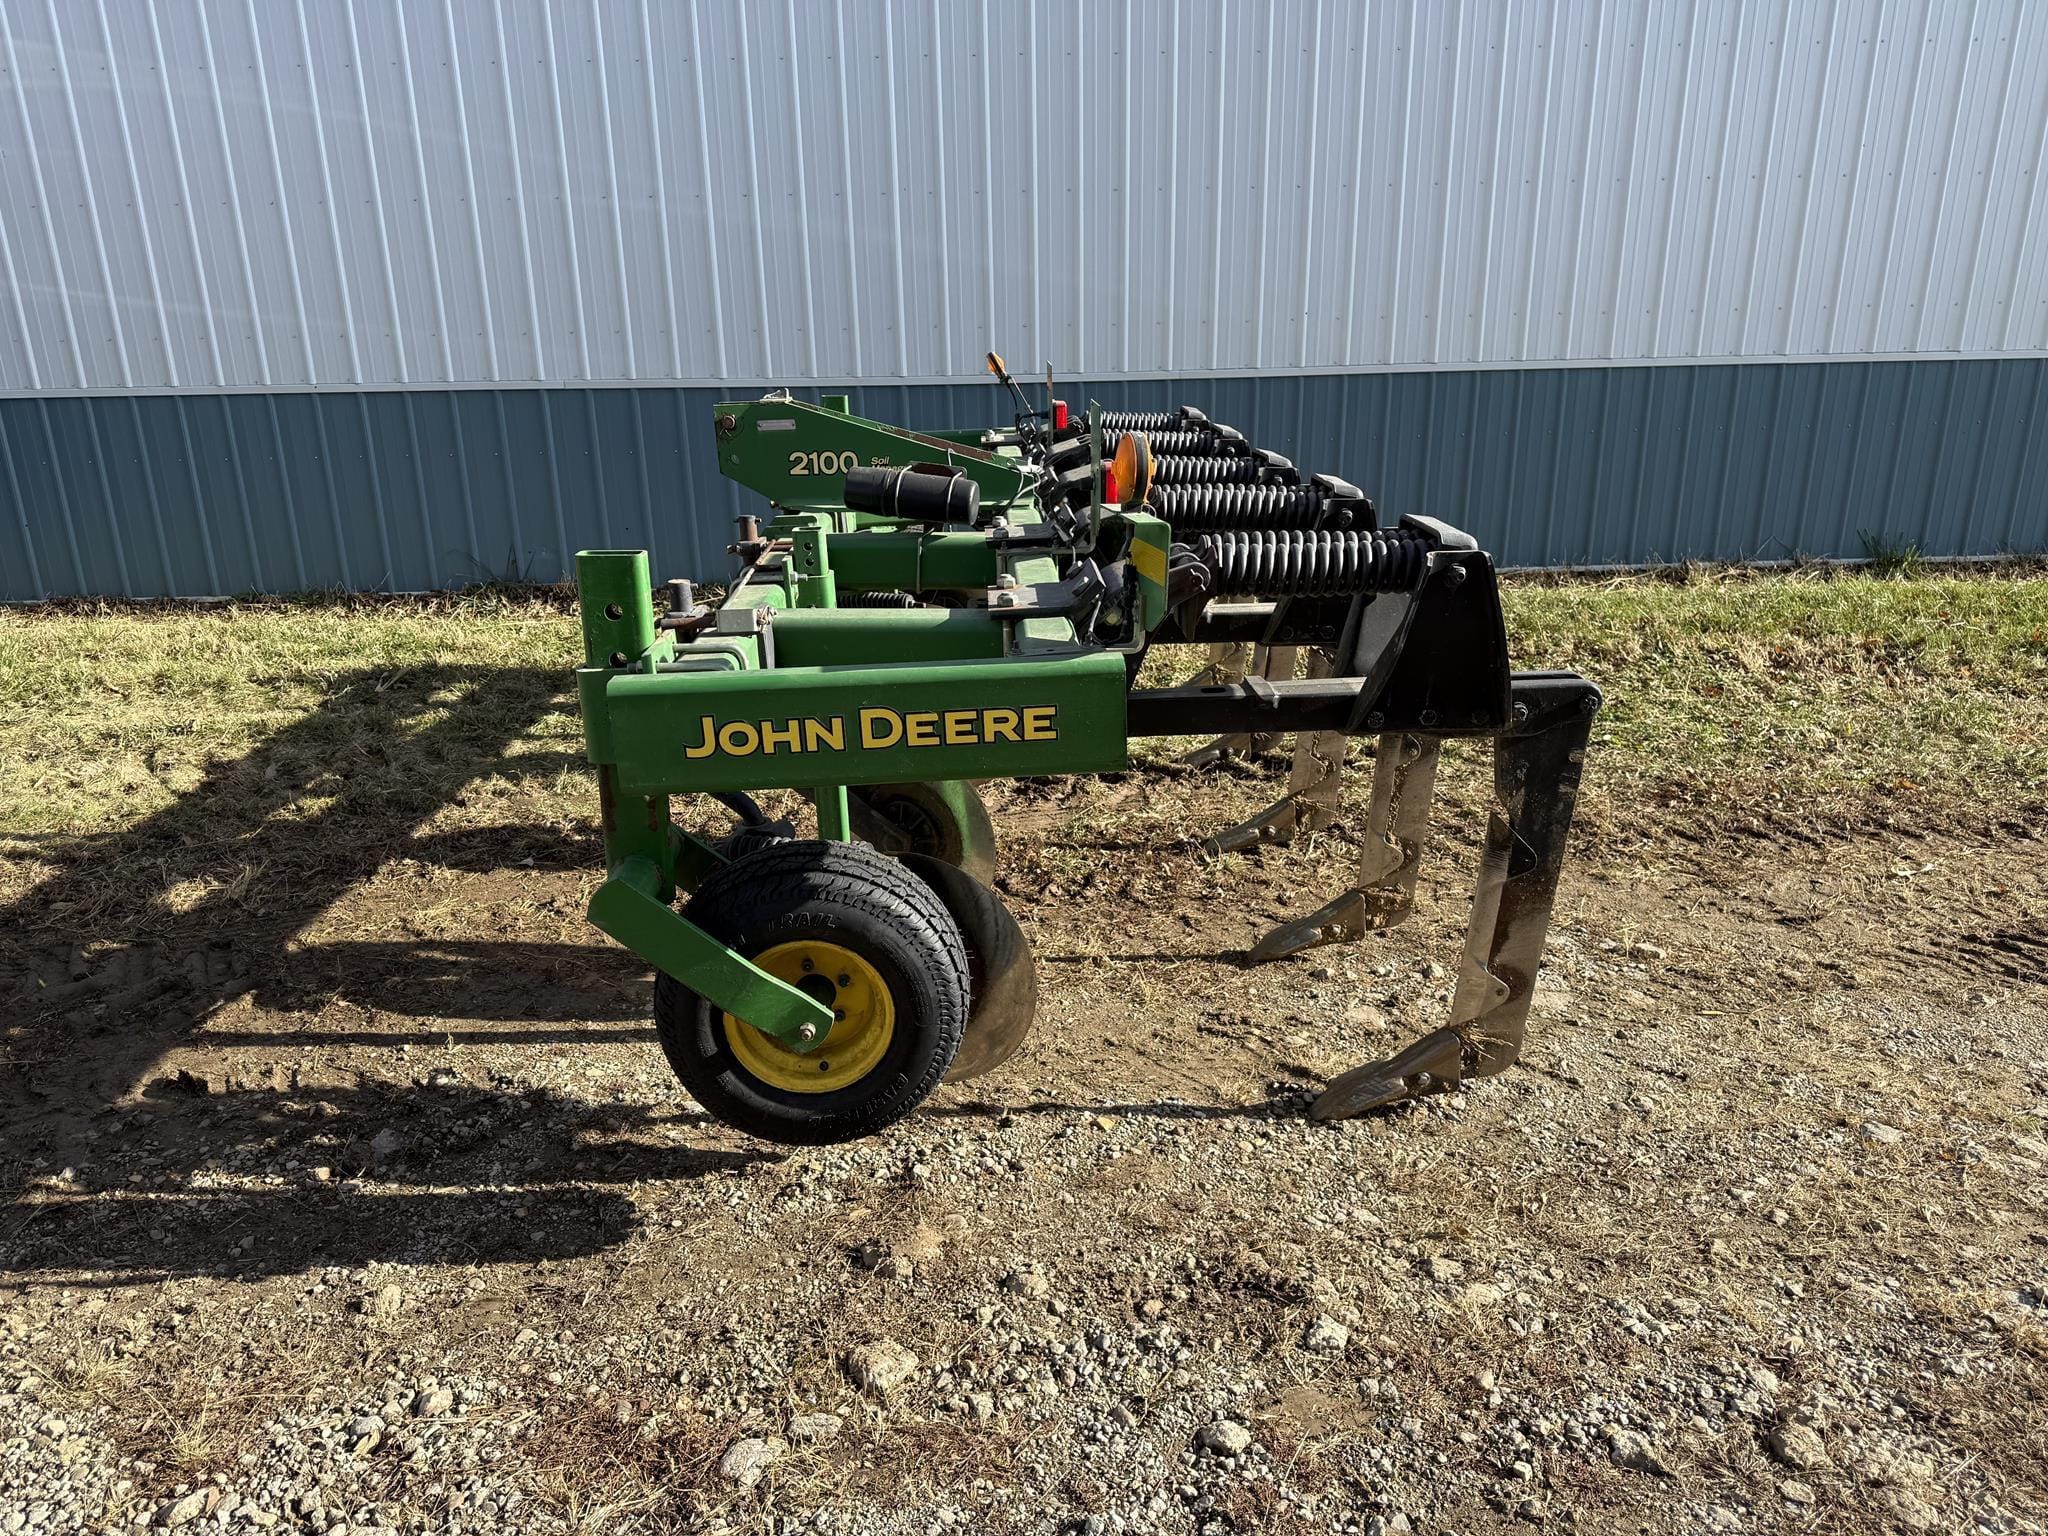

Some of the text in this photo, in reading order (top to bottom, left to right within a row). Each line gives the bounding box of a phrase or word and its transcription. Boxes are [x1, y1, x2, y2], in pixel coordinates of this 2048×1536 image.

[788, 450, 859, 476] 2100
[871, 456, 890, 465] Soil
[684, 705, 1059, 759] JOHN DEERE
